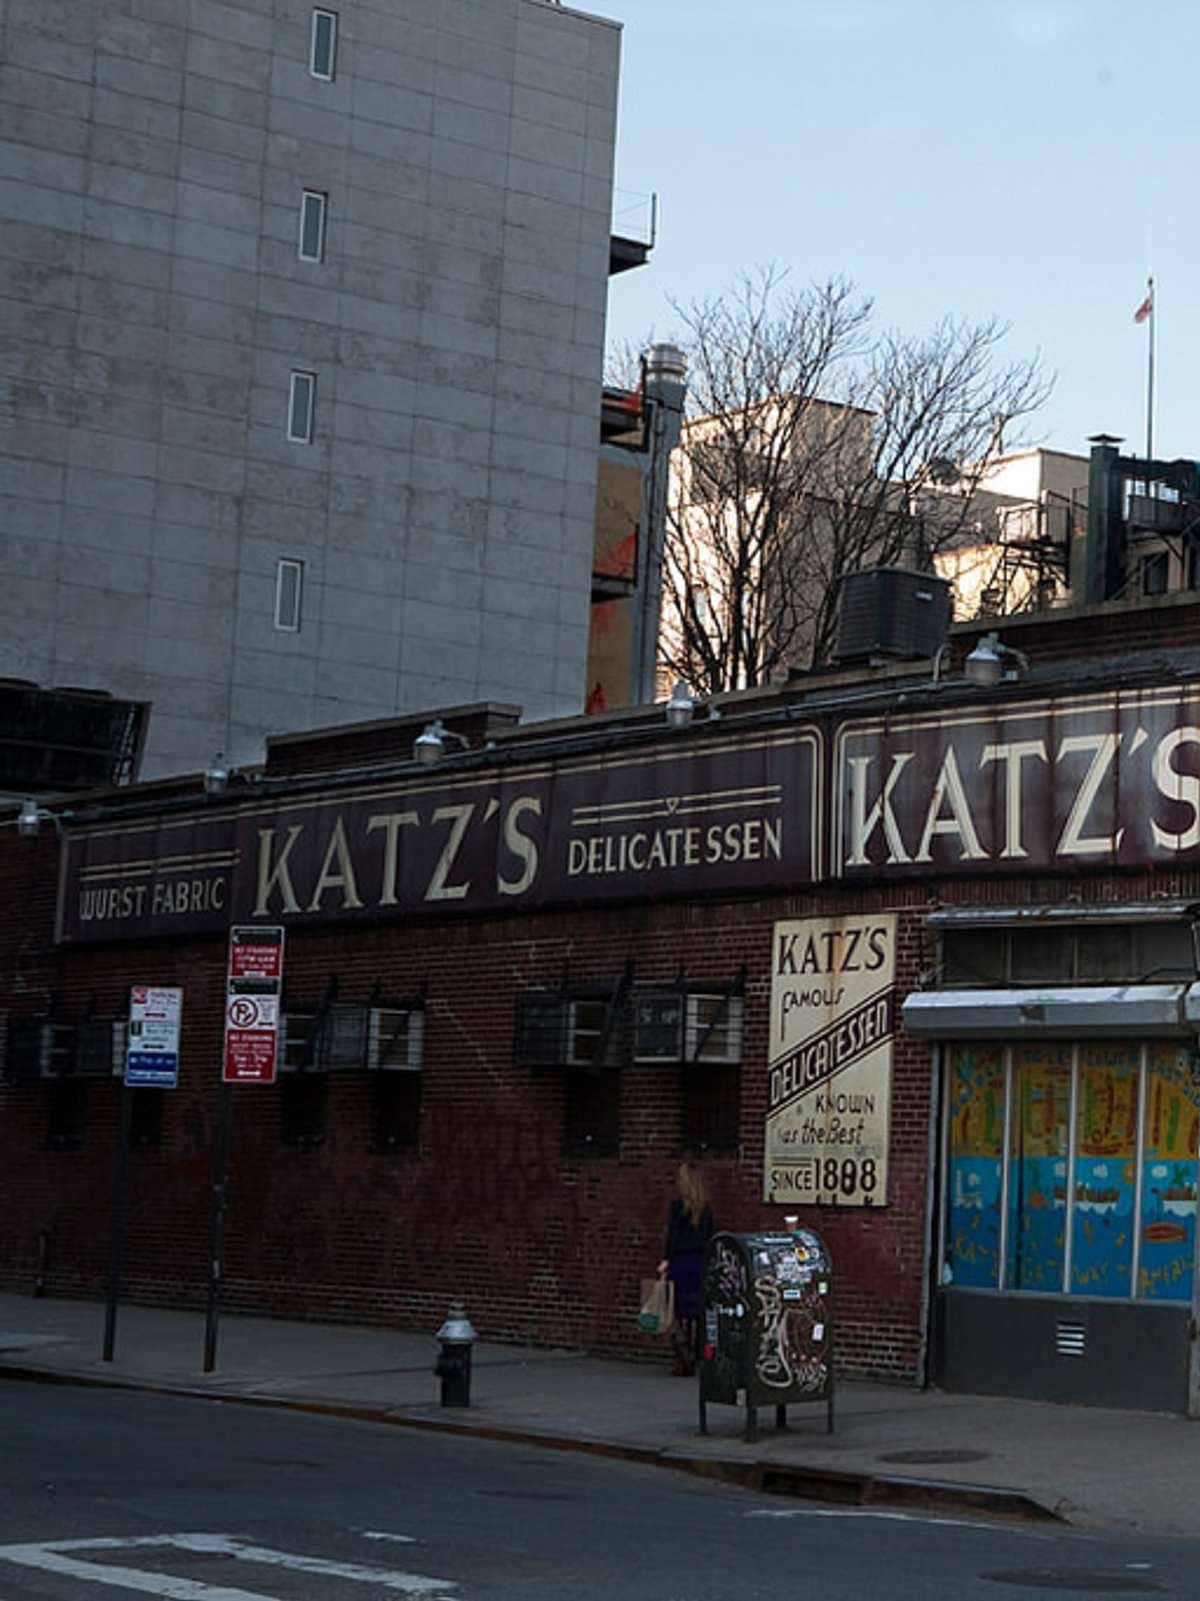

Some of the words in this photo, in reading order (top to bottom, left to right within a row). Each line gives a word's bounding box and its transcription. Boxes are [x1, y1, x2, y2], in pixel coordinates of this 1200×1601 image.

[252, 796, 542, 917] KATZ'S
[567, 818, 783, 876] DELICATESSEN
[79, 884, 145, 921] WURST
[152, 877, 226, 916] FABRIC
[777, 926, 888, 976] KATZ'S
[781, 987, 845, 1042] FAMOUS
[770, 1000, 889, 1106] DELICATESSEN
[815, 1094, 876, 1114] KNOWN
[771, 1170, 813, 1191] SINCE
